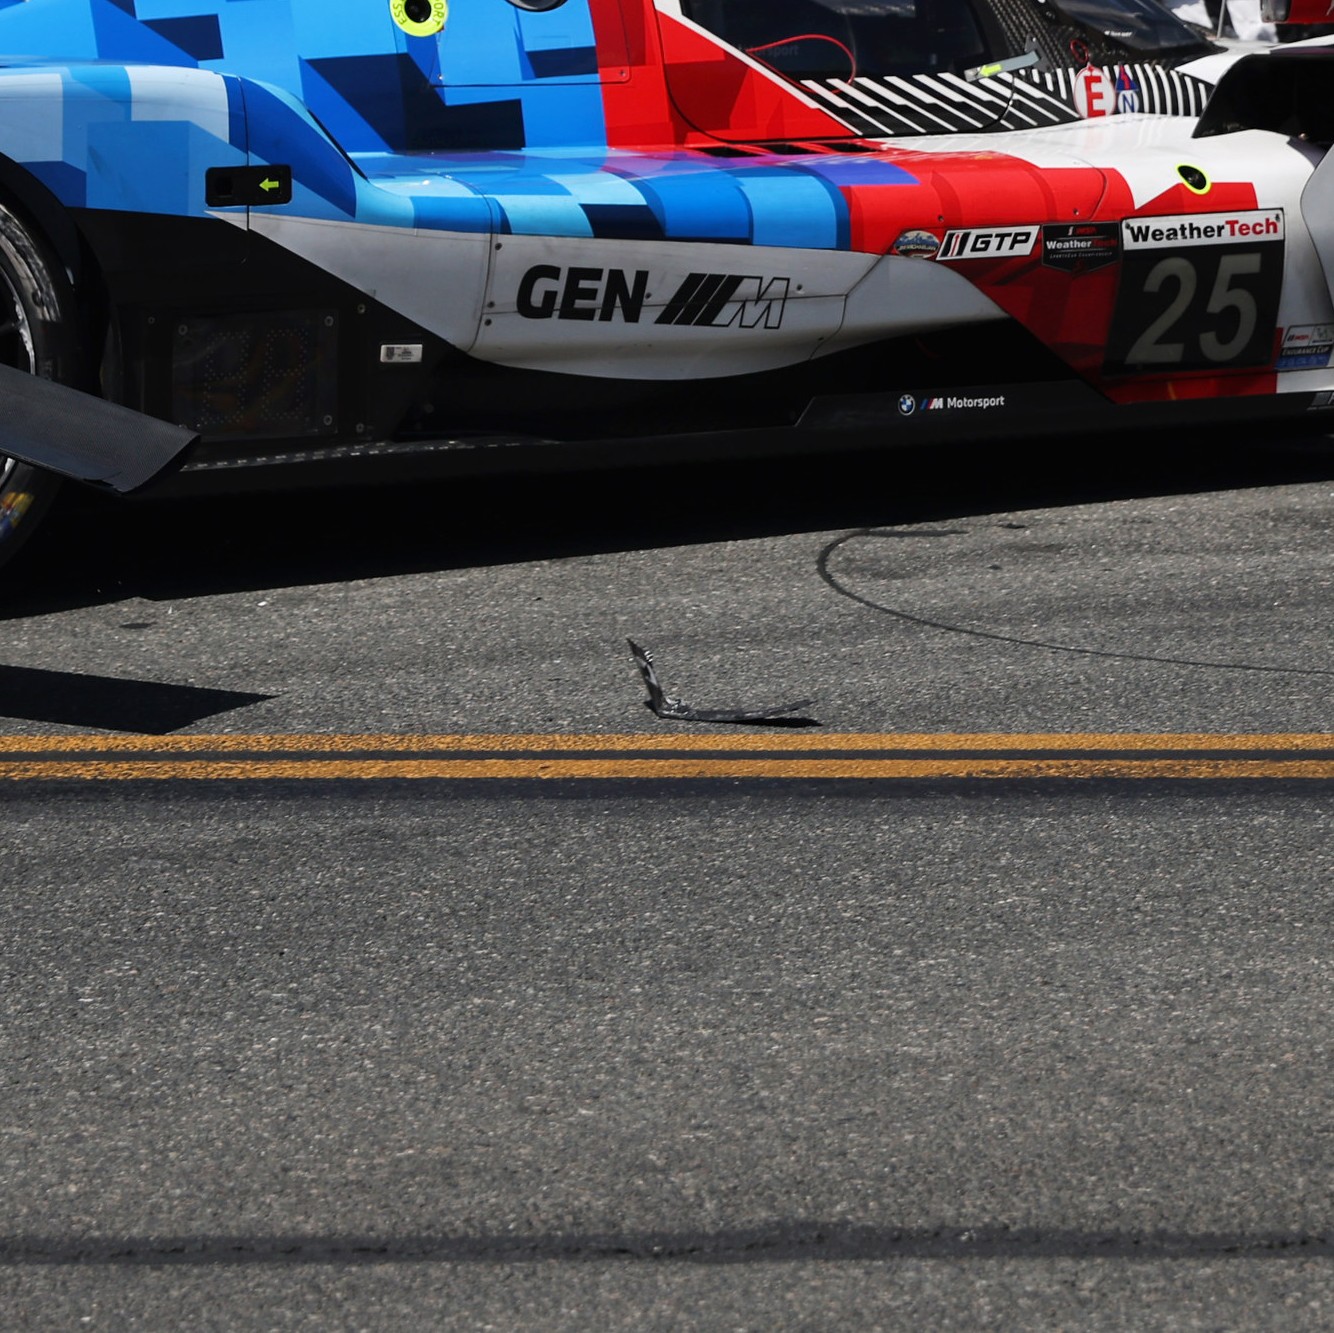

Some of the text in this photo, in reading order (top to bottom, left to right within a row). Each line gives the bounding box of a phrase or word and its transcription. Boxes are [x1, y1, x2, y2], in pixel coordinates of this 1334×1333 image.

[1083, 75, 1106, 118] E
[1122, 93, 1135, 114] N
[969, 231, 1032, 253] GTP
[1130, 218, 1279, 243] WeatherTech
[1046, 238, 1117, 250] WeatherTech
[516, 264, 650, 323] GEN
[1124, 252, 1262, 365] 25
[947, 395, 1005, 410] Motorsport
